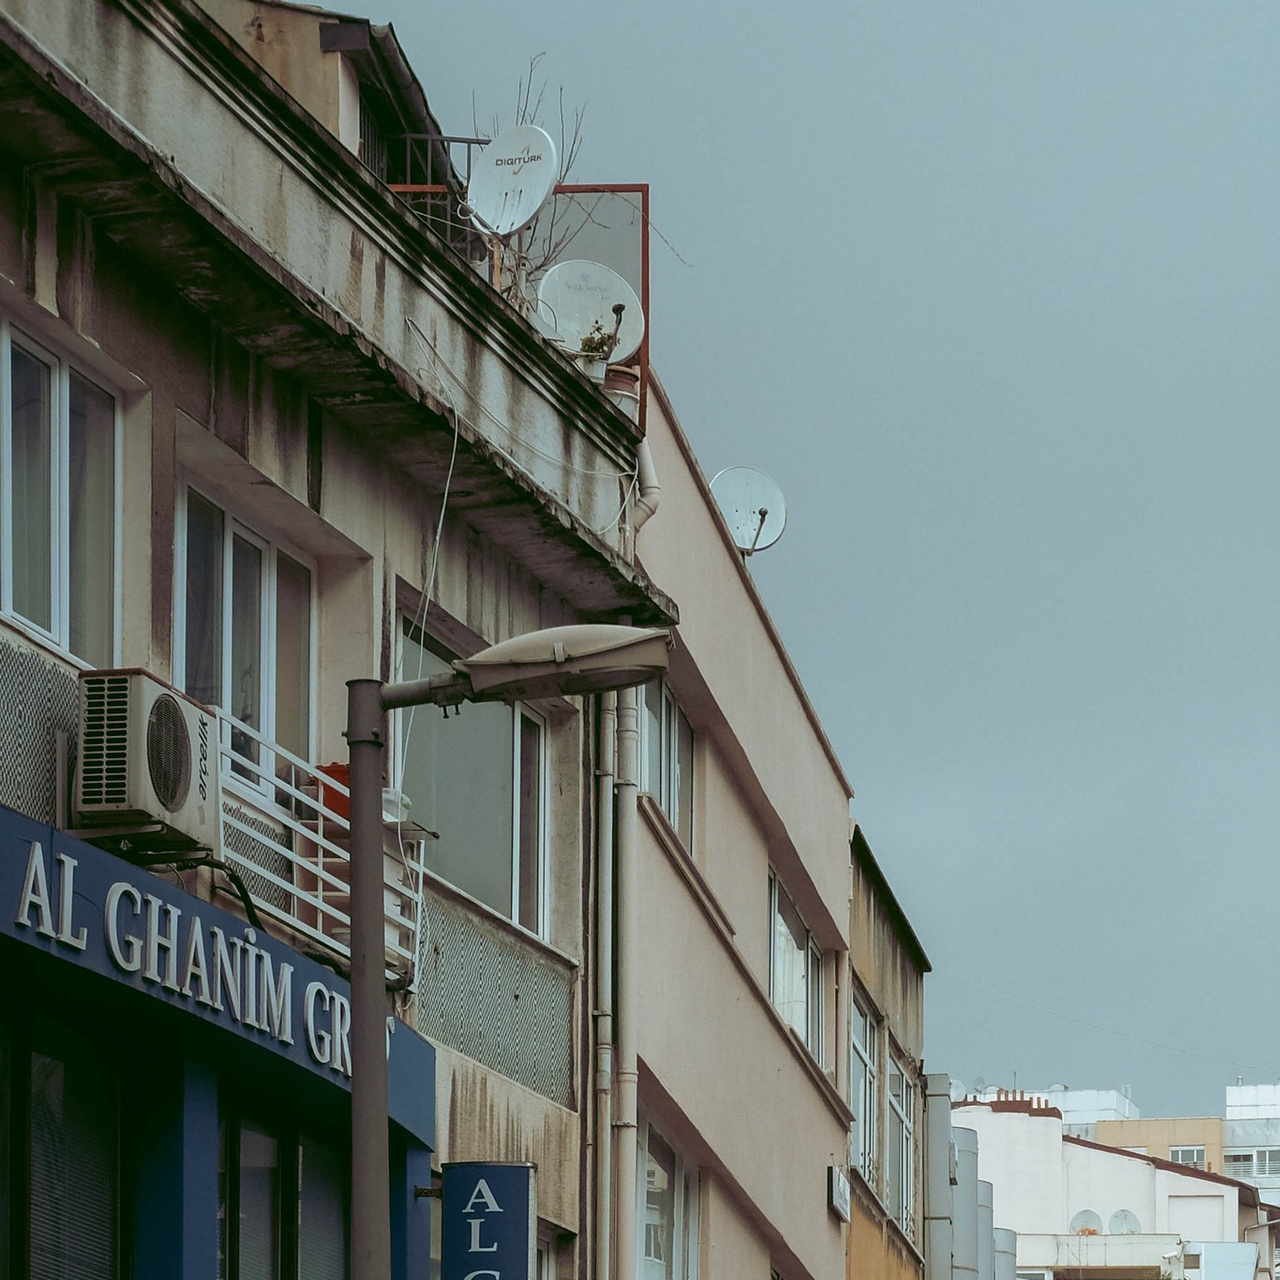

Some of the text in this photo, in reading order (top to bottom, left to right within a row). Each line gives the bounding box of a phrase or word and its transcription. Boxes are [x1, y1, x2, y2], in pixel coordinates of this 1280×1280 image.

[15, 841, 88, 951] AL
[104, 882, 294, 1046] GHANİM
[462, 1178, 504, 1253] AL
